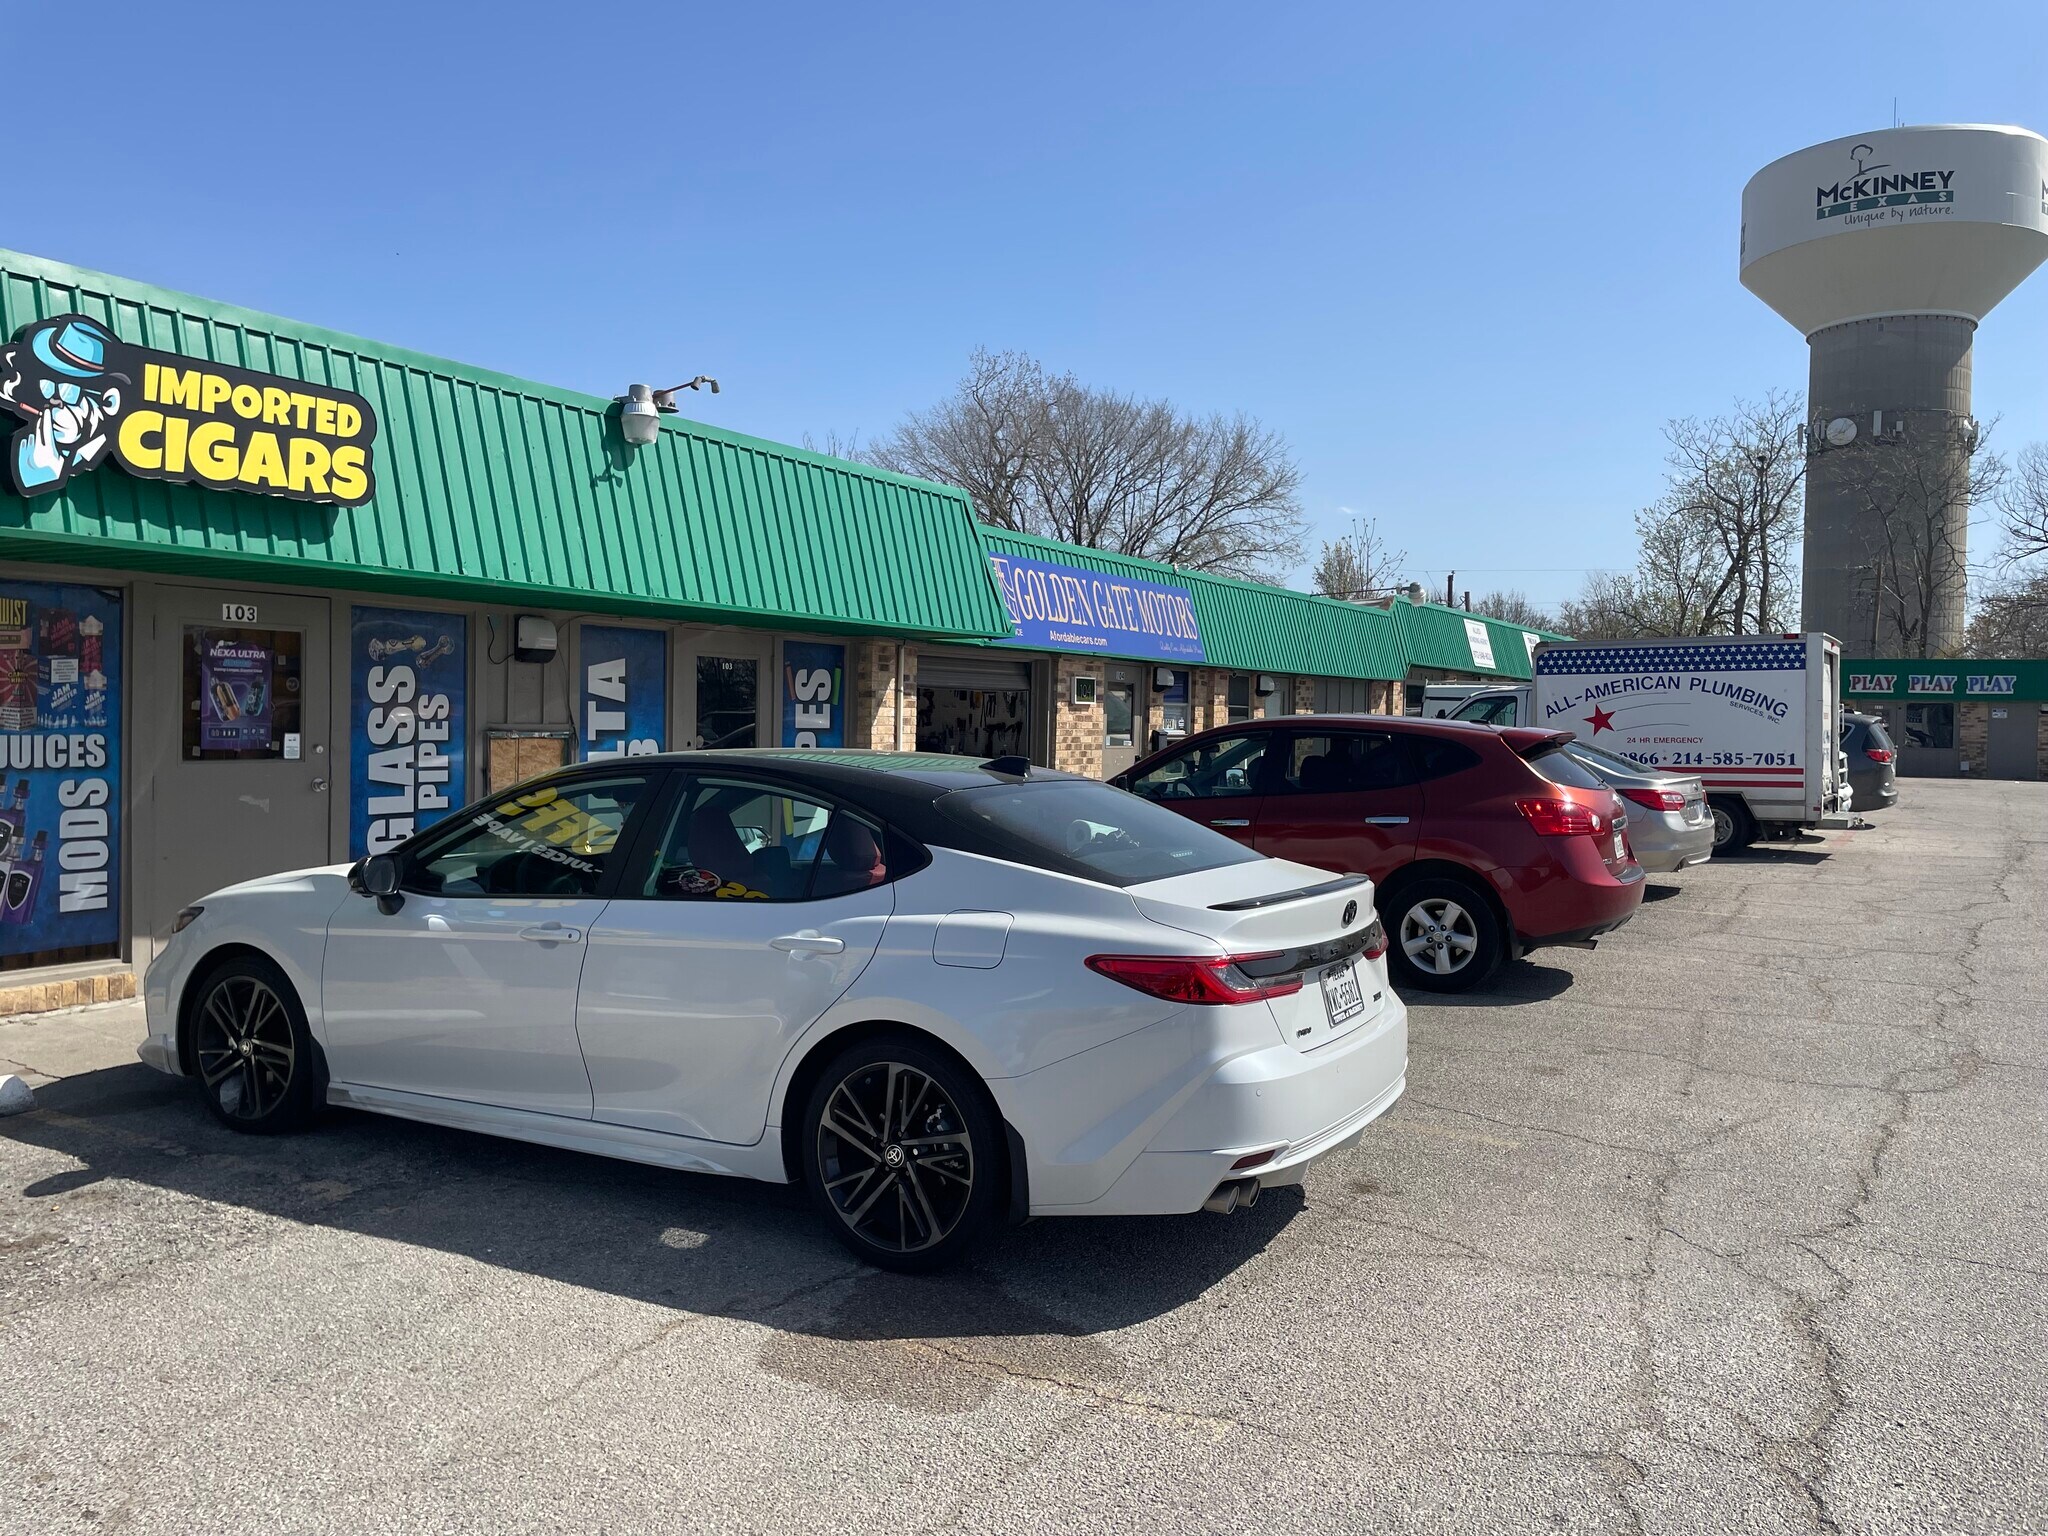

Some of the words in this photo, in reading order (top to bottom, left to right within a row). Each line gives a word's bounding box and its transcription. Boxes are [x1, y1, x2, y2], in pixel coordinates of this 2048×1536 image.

[1817, 171, 1955, 207] McKINNEY
[1823, 192, 1948, 216] TEXAS
[1844, 212, 1885, 227] Unique
[1891, 207, 1904, 222] by
[1909, 204, 1954, 217] nature.
[144, 363, 362, 438] IMPORTED
[118, 410, 368, 500] CIGARS
[225, 606, 255, 622] 103
[1014, 567, 1095, 628] GOLDEN
[1093, 580, 1139, 632] GATE
[1135, 588, 1198, 640] MOTORS
[210, 648, 236, 658] NEXA
[237, 650, 266, 659] ULTRA
[722, 662, 733, 670] 103
[52, 683, 71, 700] JAM
[1850, 676, 1896, 692] PLAY
[1909, 676, 1956, 693] PLAY
[1967, 676, 2015, 693] PLAY
[1545, 675, 1681, 719] ALL-AMERICAN
[1689, 677, 1789, 719] PLUMBING
[1729, 700, 1765, 718] SERVICES,
[1767, 714, 1781, 725] INC.
[0, 733, 107, 769] JUICES
[367, 665, 415, 856] GLASS
[418, 694, 450, 810] PIPES
[1672, 752, 1797, 766] 214-585-7051
[59, 777, 109, 914] MODS
